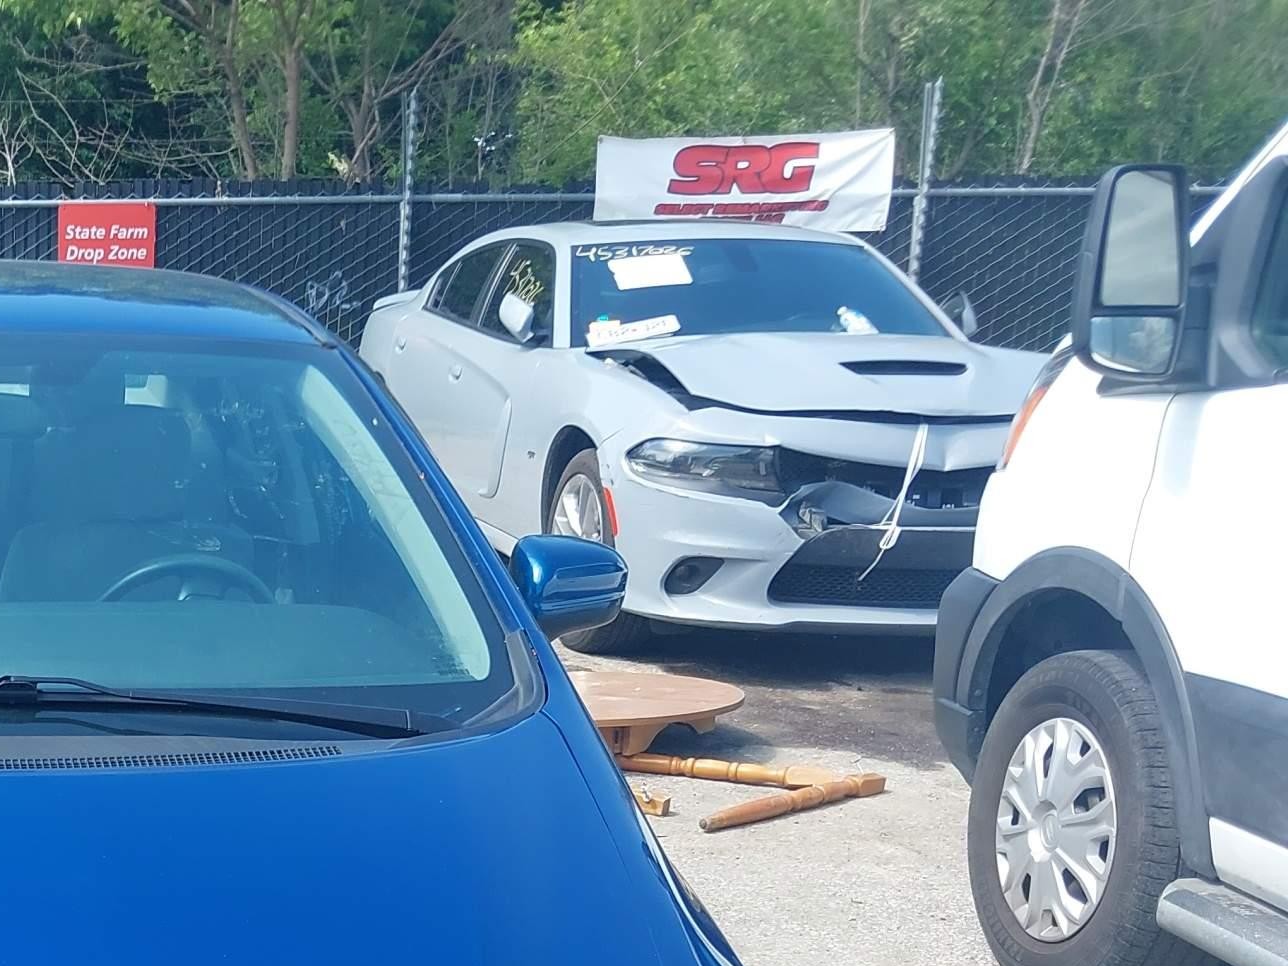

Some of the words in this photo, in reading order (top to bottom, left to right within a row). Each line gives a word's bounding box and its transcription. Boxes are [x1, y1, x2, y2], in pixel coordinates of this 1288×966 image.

[667, 142, 820, 194] SRG
[65, 225, 105, 239] State
[110, 225, 148, 239] Farm
[66, 246, 104, 264] Drop
[108, 246, 146, 259] Zone
